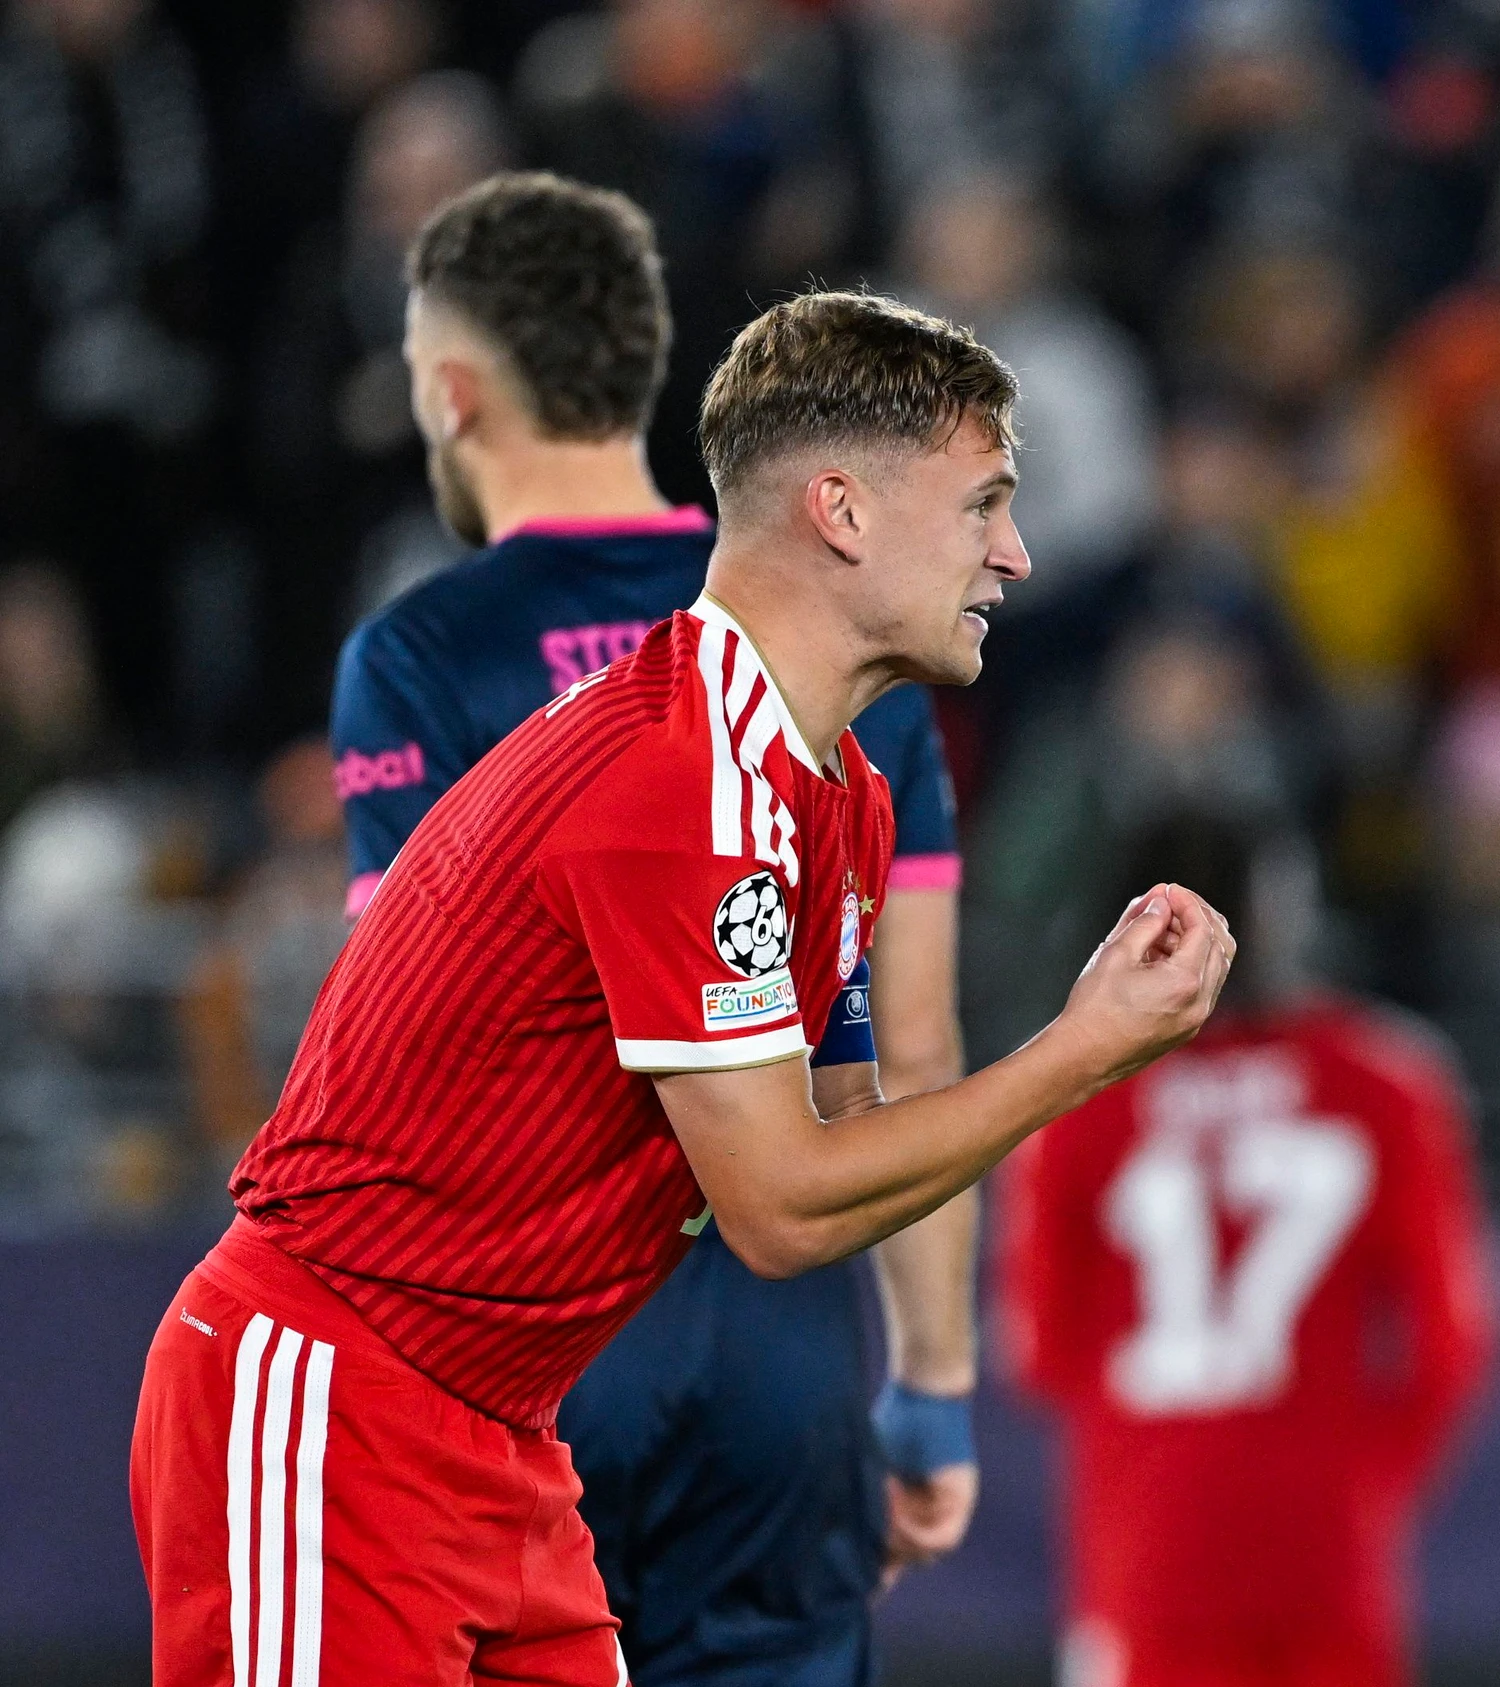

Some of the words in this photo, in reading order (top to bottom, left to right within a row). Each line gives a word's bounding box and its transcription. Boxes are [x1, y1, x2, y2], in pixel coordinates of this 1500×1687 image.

[751, 904, 773, 946] 6
[706, 986, 738, 998] UEFA
[706, 982, 795, 1015] FOUNDATIO
[1100, 1115, 1375, 1416] 17
